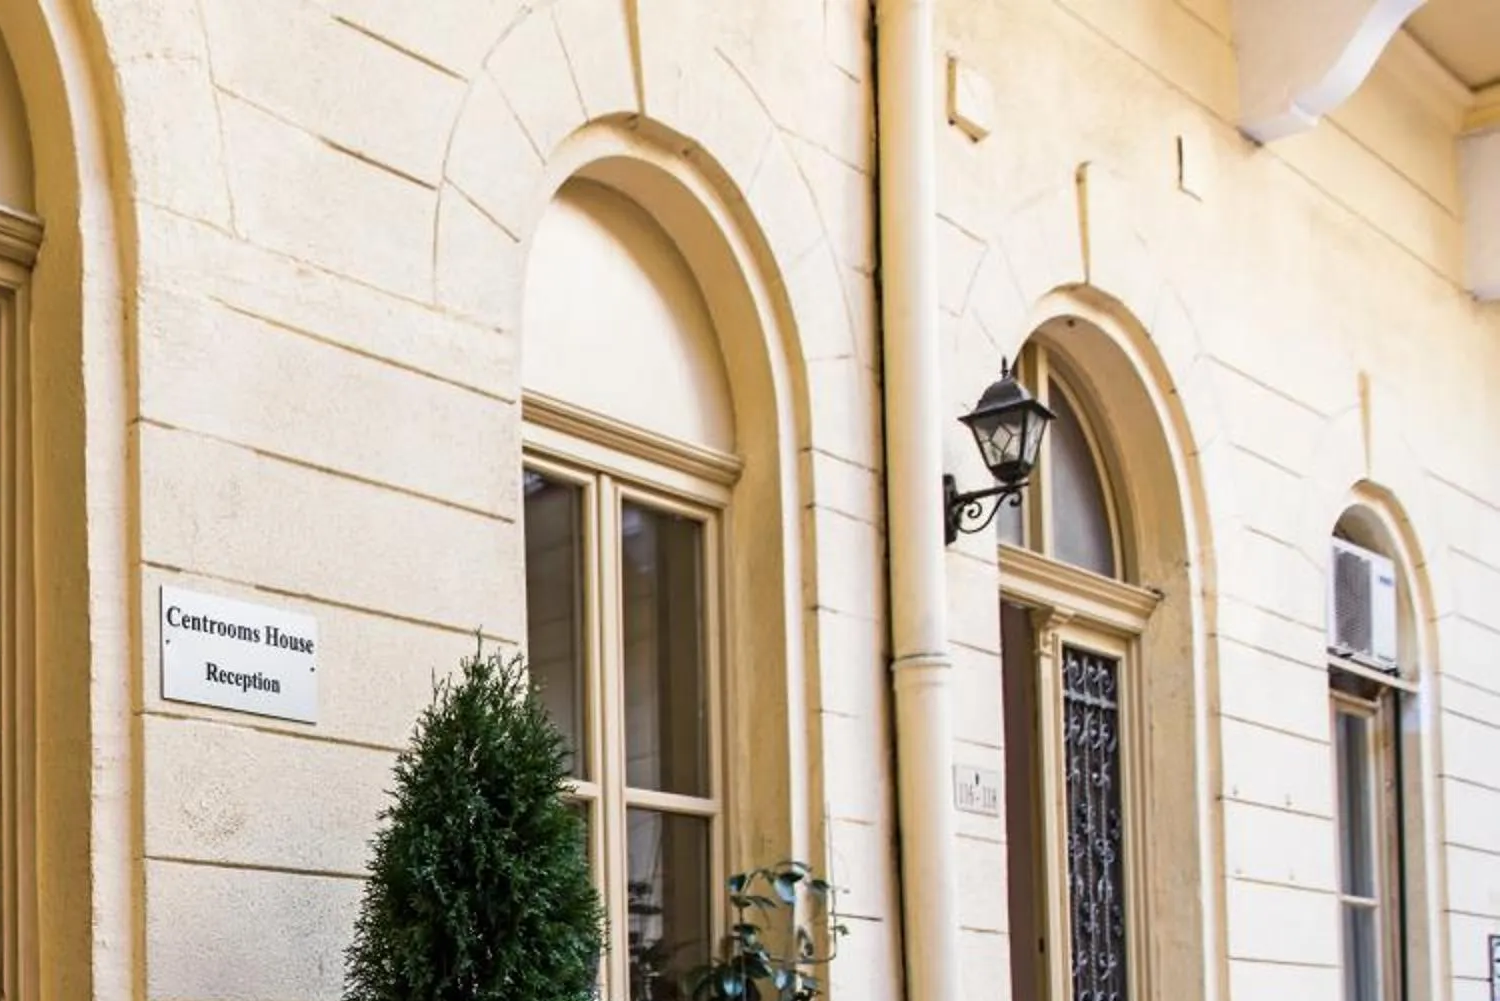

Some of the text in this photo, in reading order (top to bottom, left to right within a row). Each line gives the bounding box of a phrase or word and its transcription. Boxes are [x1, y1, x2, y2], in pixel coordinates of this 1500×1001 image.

[166, 605, 314, 654] Centrooms House
[206, 661, 281, 694] Reception
